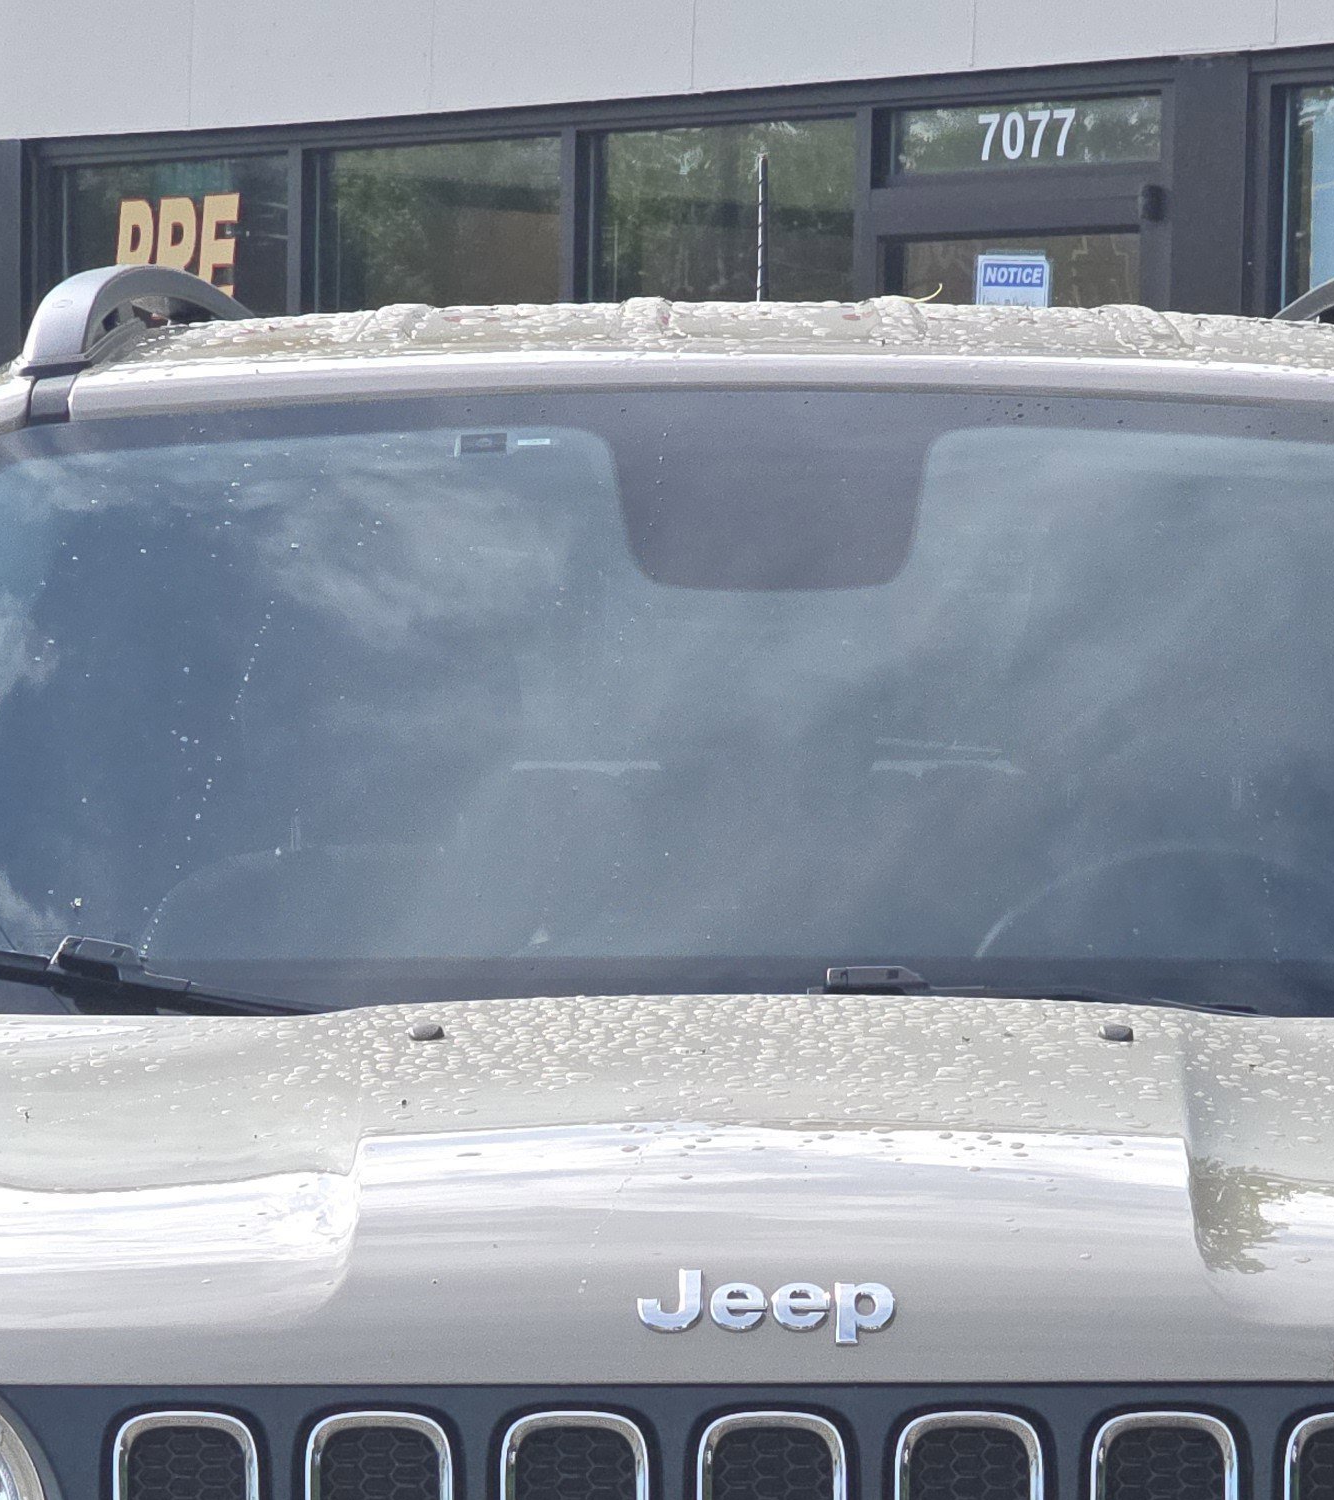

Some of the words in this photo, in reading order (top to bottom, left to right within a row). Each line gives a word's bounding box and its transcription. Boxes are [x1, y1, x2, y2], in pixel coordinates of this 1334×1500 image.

[978, 108, 1076, 160] 7077
[985, 267, 1042, 284] NOTICE
[636, 1268, 896, 1345] Jeep
